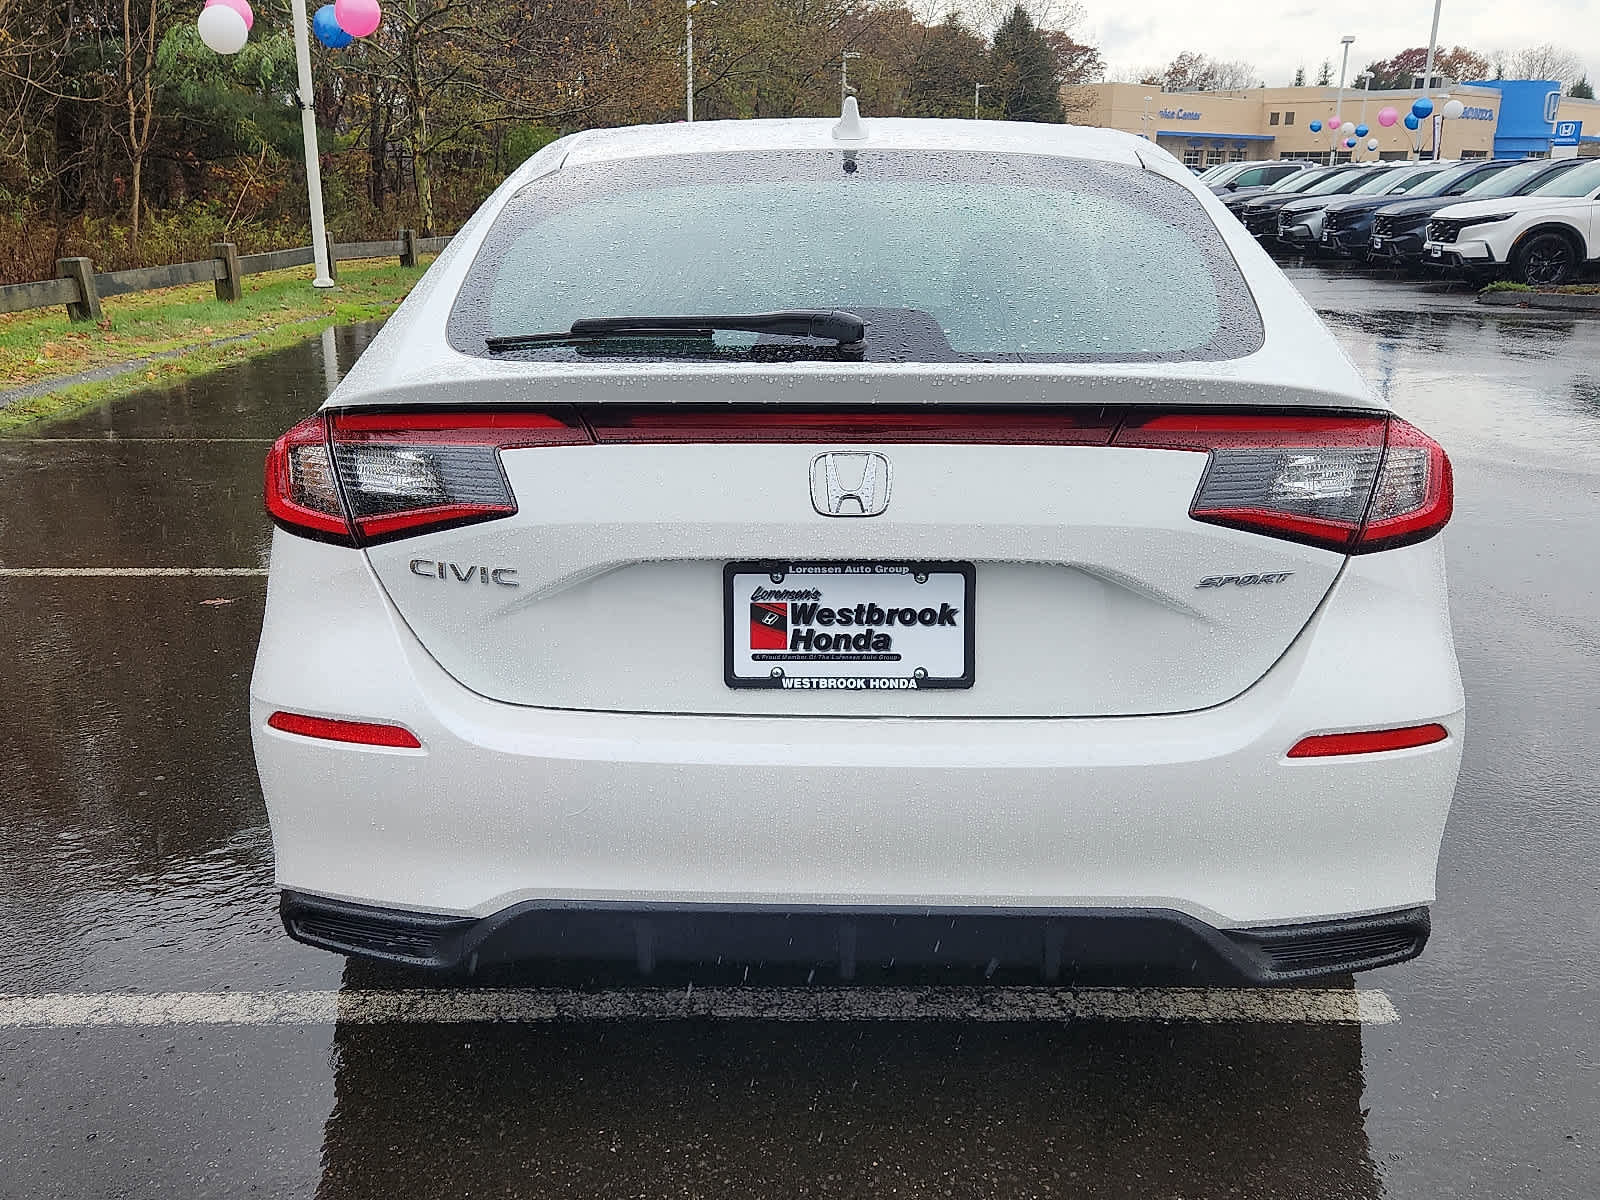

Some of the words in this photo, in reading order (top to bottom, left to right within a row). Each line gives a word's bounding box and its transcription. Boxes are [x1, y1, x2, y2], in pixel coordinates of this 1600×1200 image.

[409, 559, 519, 587] CIVIC
[788, 565, 842, 574] Lorensen
[844, 565, 871, 574] Auto
[874, 565, 910, 576] Group
[1194, 570, 1296, 589] SPORT
[750, 586, 822, 602] Lorensen's
[790, 602, 958, 627] Westbrook
[789, 628, 892, 652] Honda
[781, 678, 866, 689] WESTBROOK
[869, 678, 918, 689] HONDA
